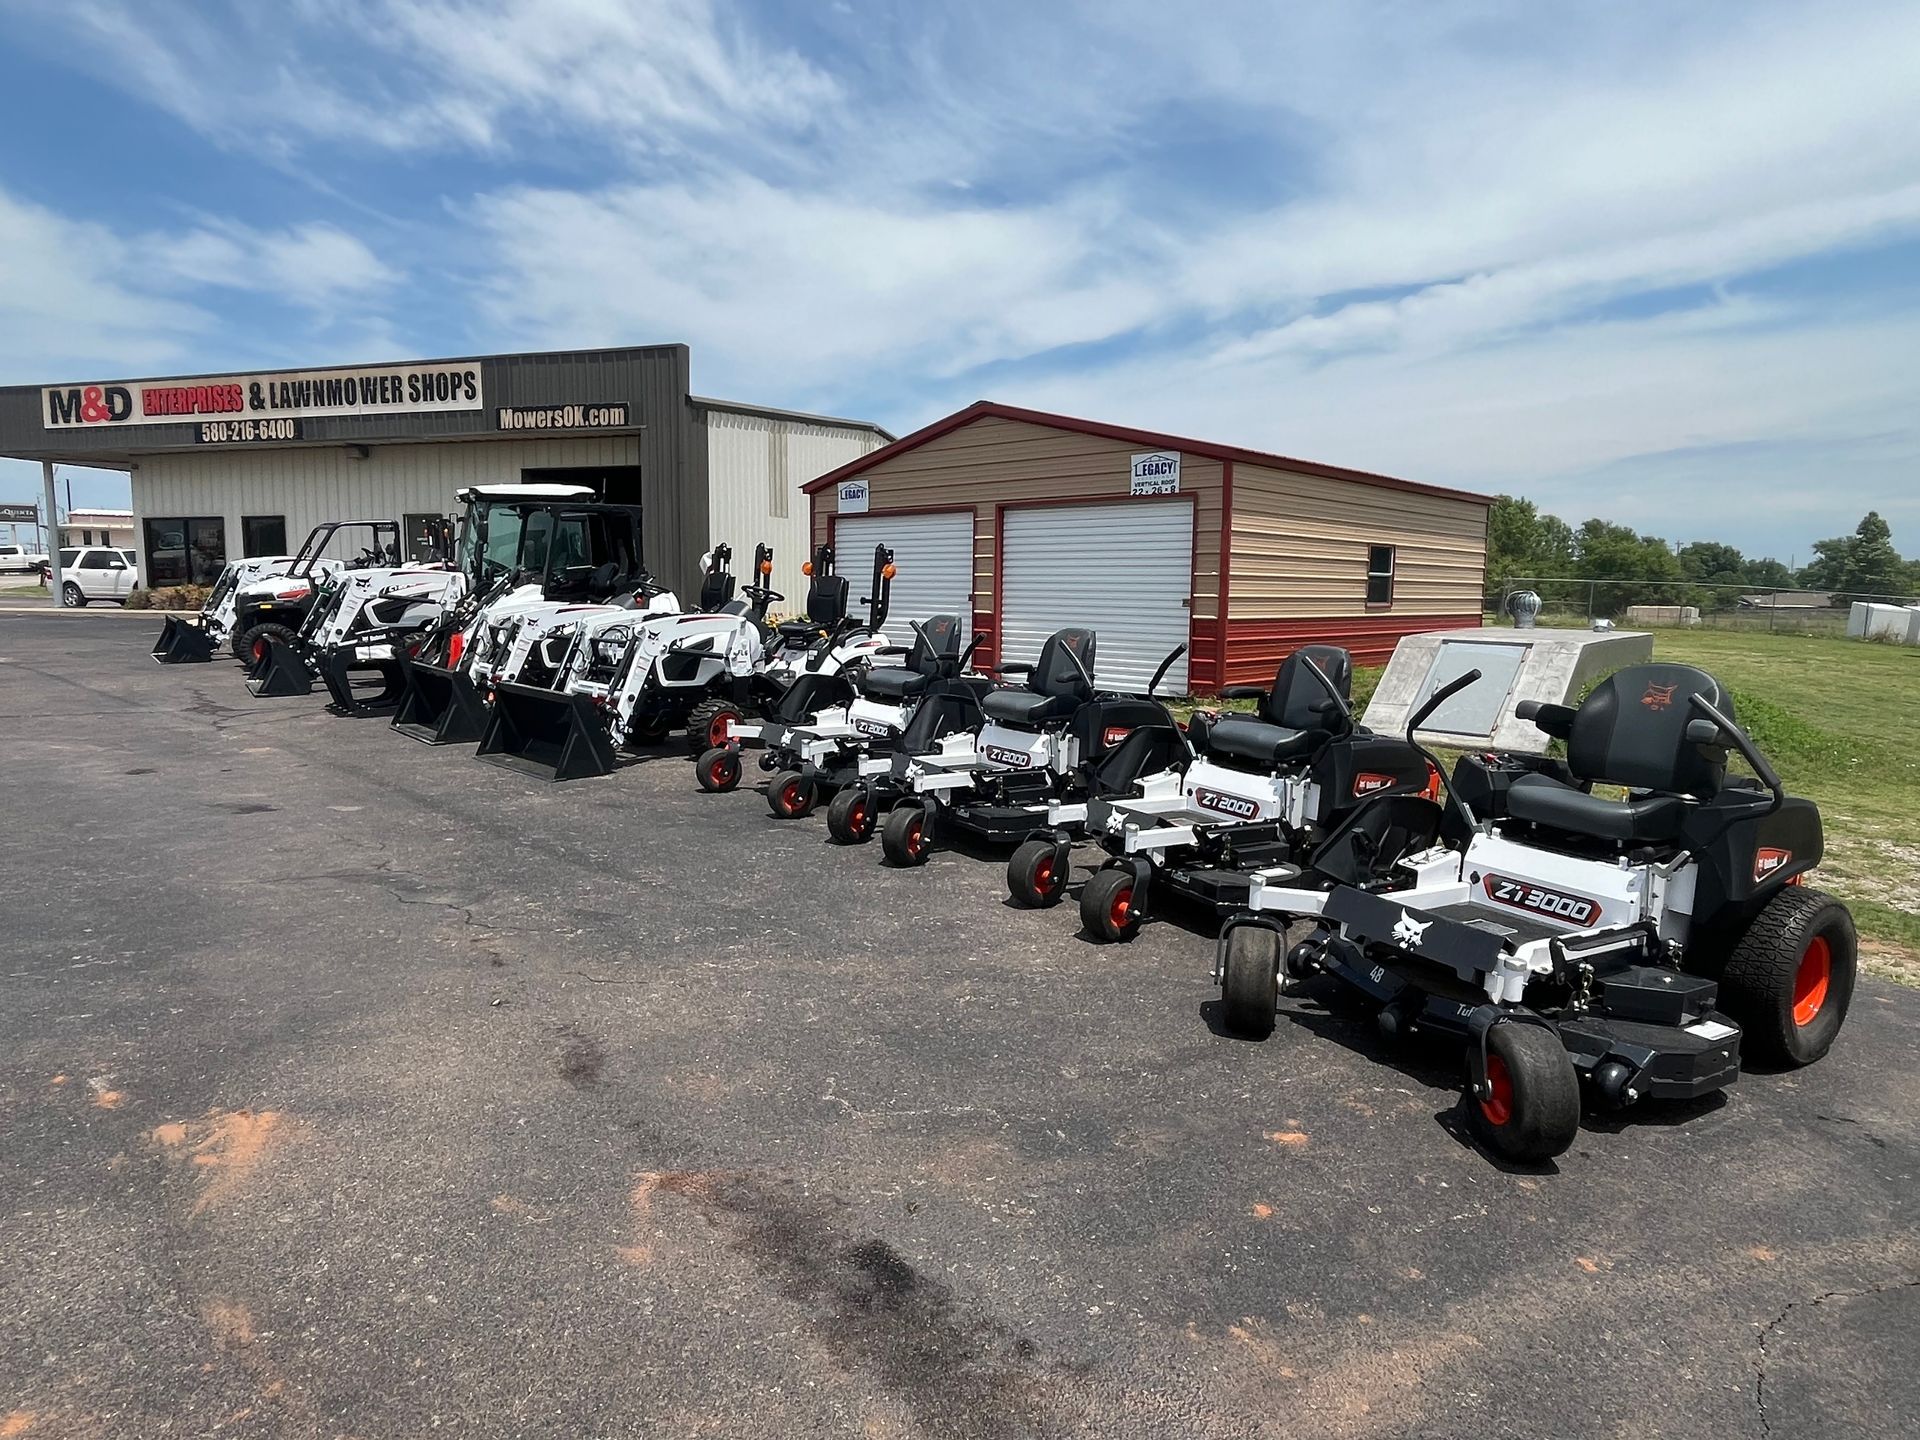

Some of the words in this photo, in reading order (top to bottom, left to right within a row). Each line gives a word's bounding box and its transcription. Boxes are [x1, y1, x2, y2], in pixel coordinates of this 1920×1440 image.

[50, 386, 132, 424] M&D
[142, 384, 244, 416] ENTERPRISES
[250, 382, 265, 410] &
[269, 375, 403, 409] LAWNMOWER
[408, 371, 476, 402] SHOPS
[500, 405, 625, 429] MowersOK.com
[202, 419, 294, 442] 580-216-6400
[1133, 461, 1174, 477] LEGACY
[1369, 965, 1385, 983] 48
